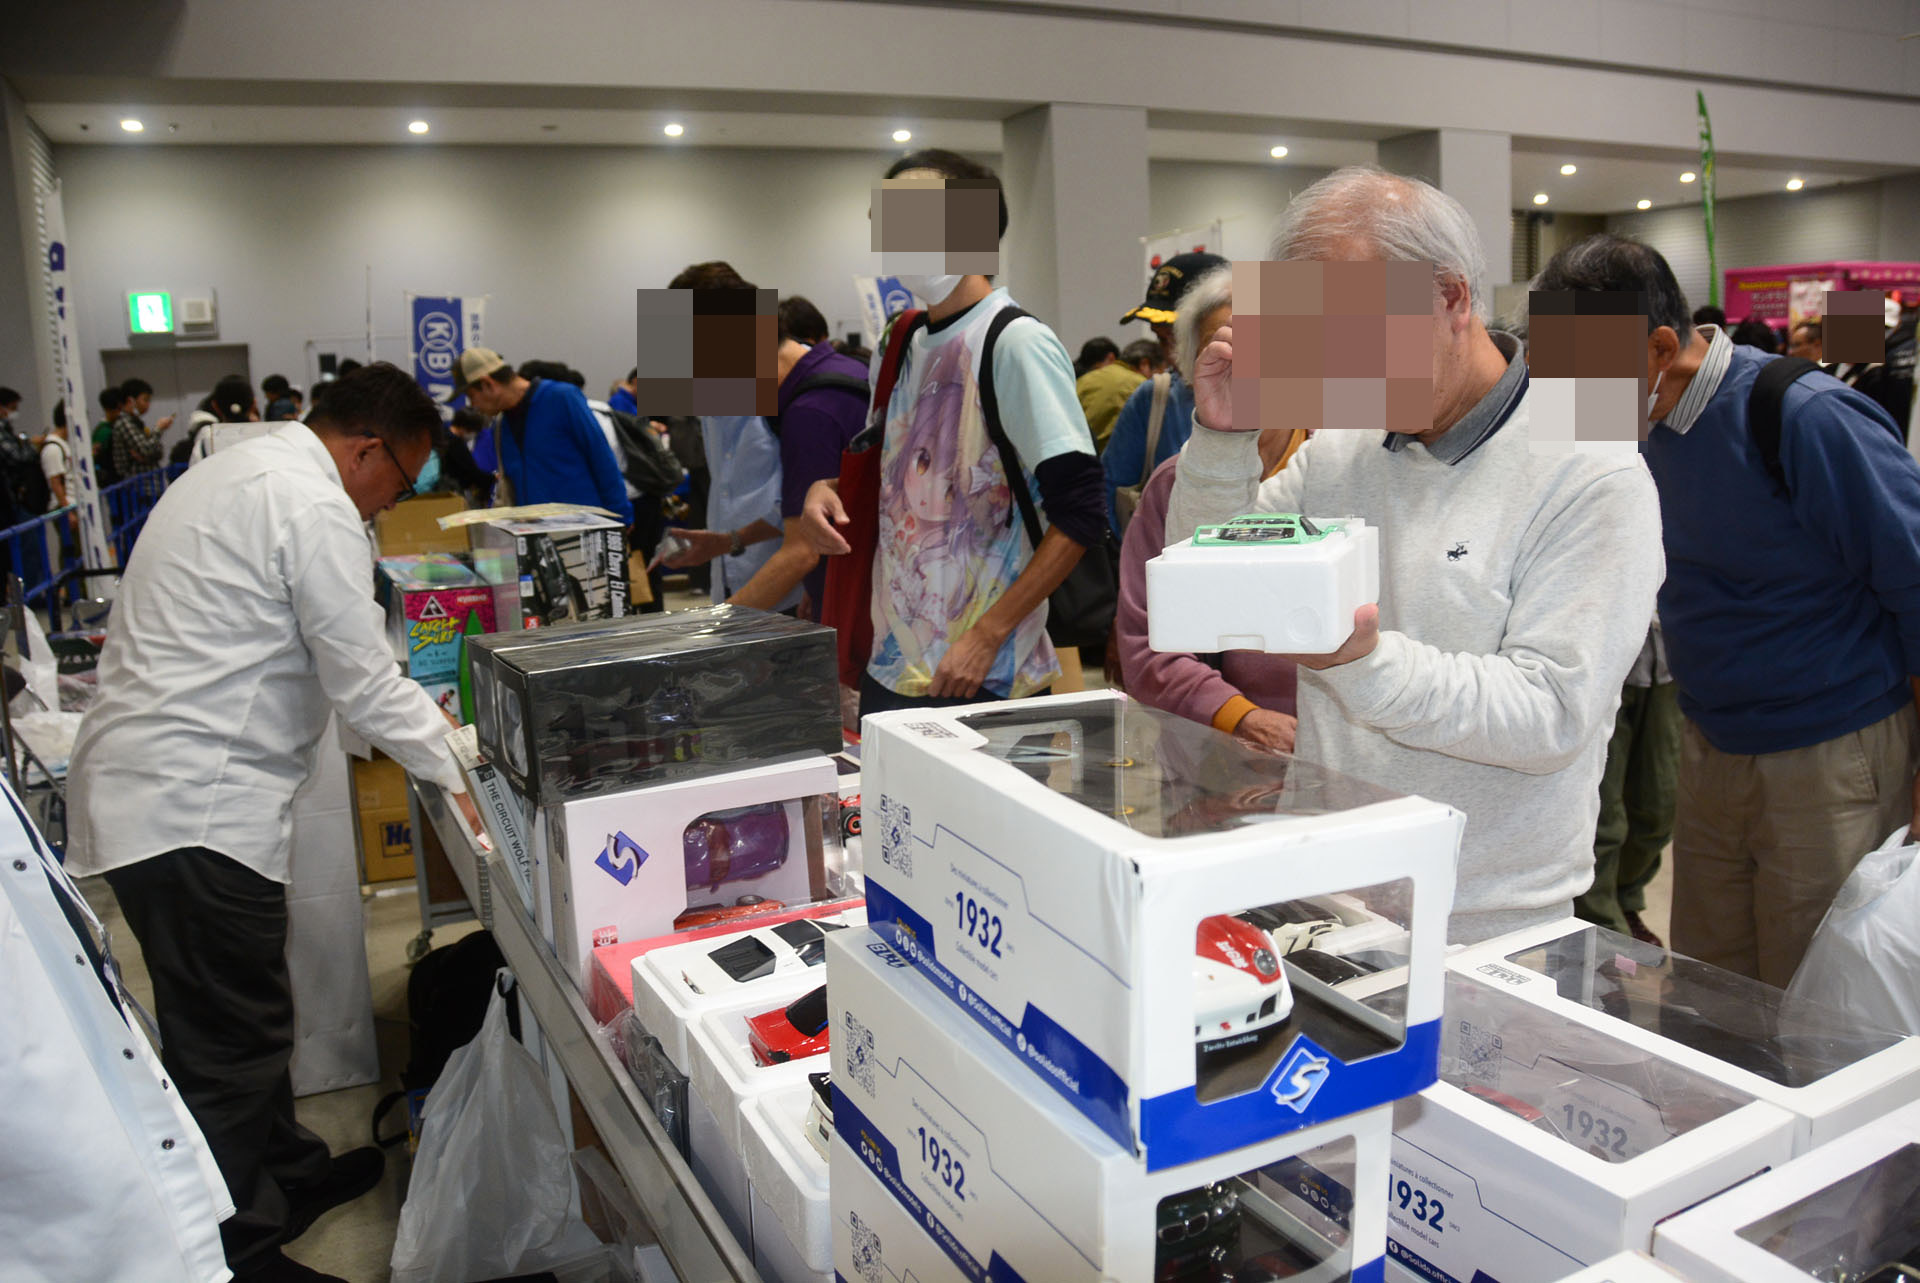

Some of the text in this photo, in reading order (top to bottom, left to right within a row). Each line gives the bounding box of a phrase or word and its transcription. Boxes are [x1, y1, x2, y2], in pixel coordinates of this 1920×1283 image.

[486, 782, 501, 802] THE
[495, 802, 516, 840] CIRCUIT
[511, 839, 531, 867] WOLF
[956, 891, 1003, 959] 1932
[918, 1126, 966, 1203] 1932
[1563, 1104, 1628, 1158] 1932
